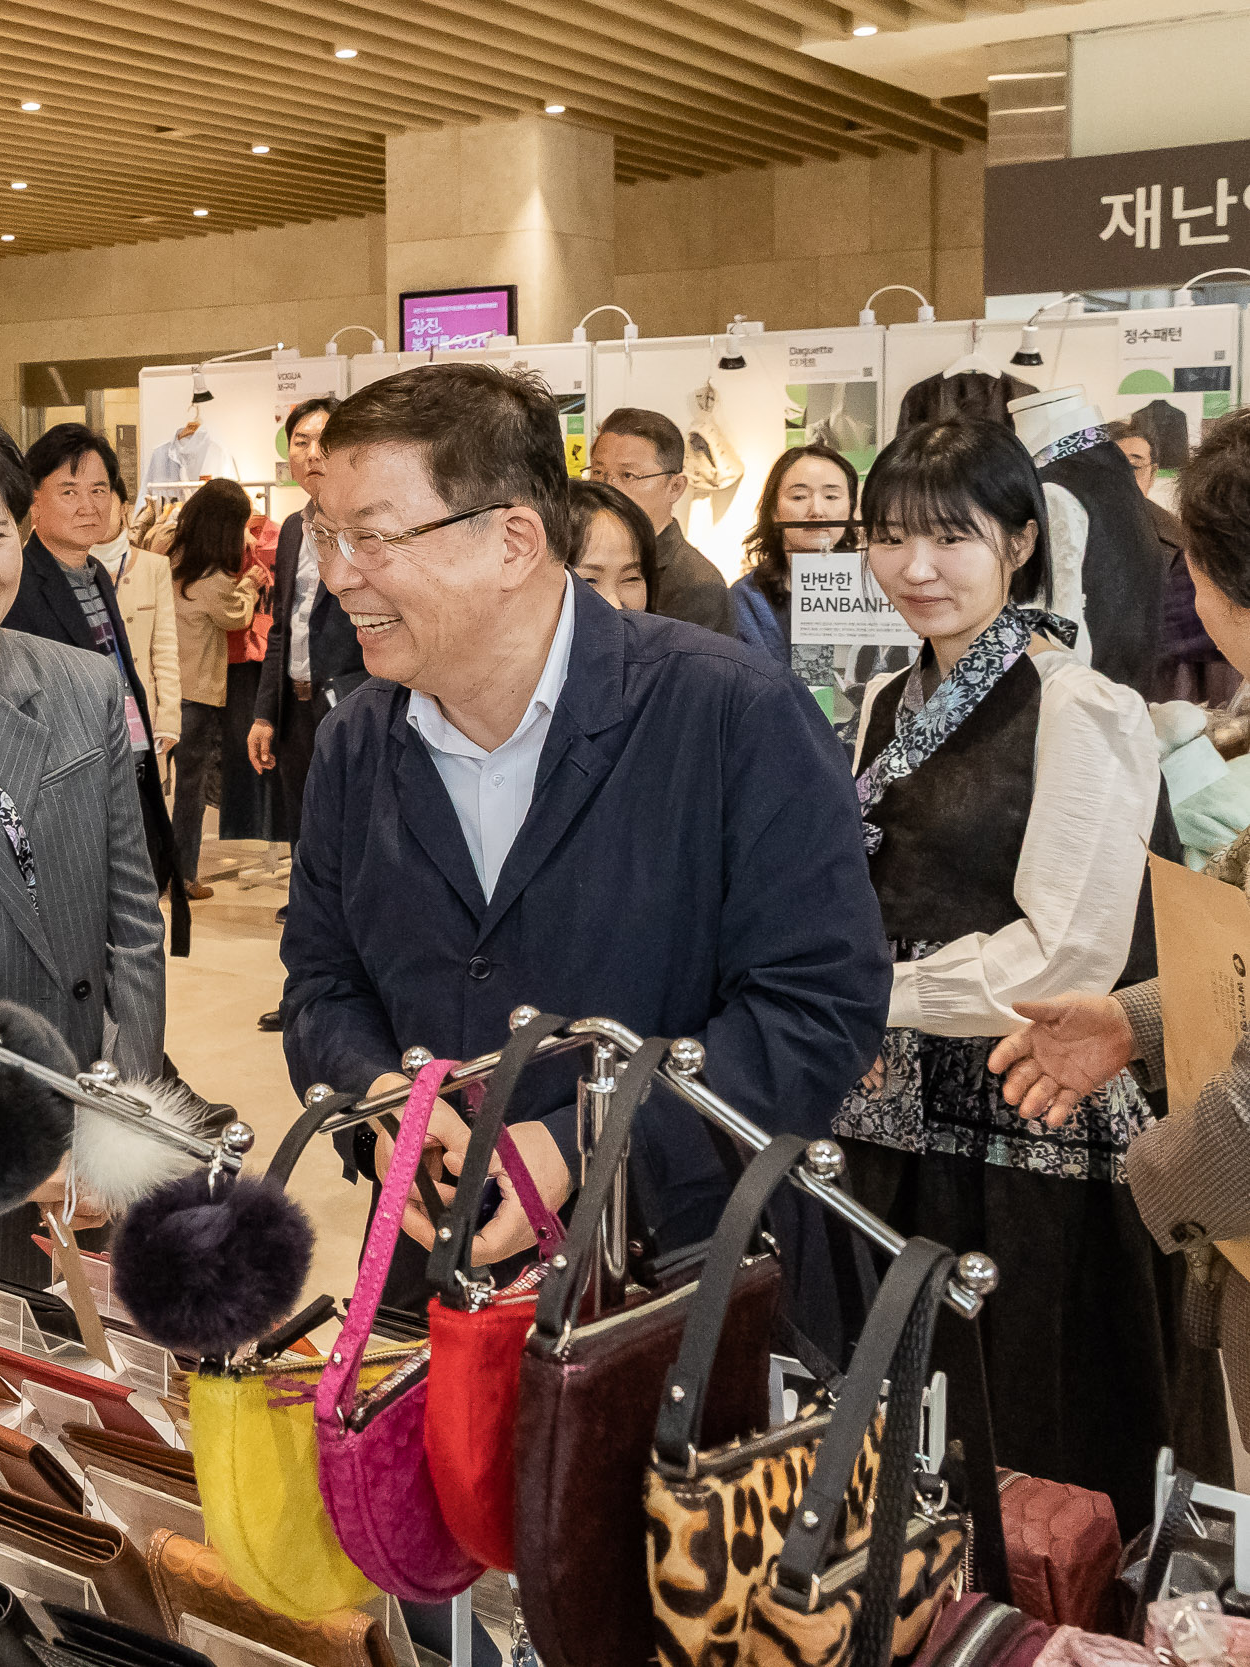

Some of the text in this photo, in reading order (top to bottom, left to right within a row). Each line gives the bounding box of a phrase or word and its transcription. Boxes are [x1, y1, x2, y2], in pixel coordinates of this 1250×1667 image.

[1100, 178, 1250, 249] 재난
[1124, 328, 1182, 345] 정수패턴
[801, 572, 852, 591] 반반한
[801, 597, 897, 613] BANBANH
